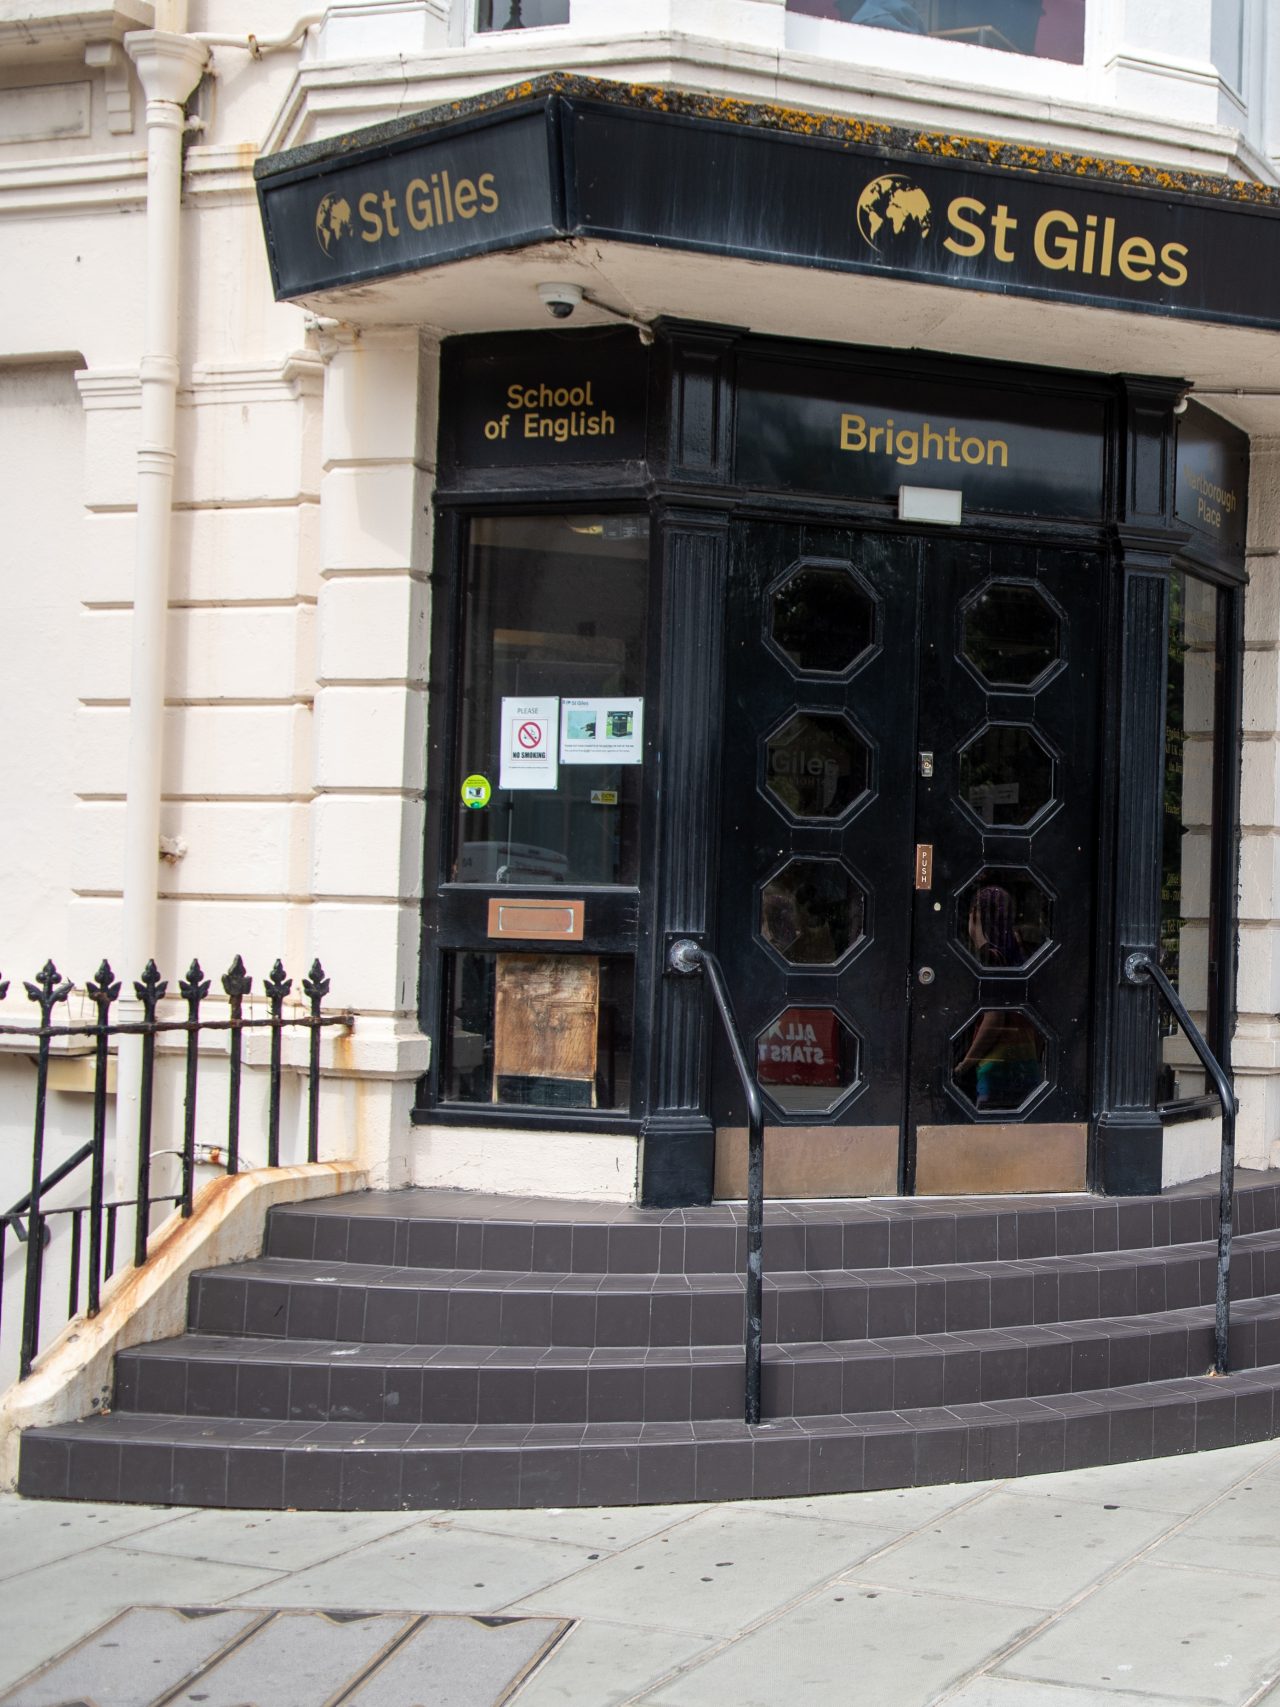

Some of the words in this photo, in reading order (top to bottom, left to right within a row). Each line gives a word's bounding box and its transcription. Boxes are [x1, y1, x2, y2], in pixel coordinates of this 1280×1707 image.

[358, 188, 400, 243] St
[405, 170, 499, 232] Giles
[942, 196, 1018, 263] St
[1033, 209, 1189, 287] Giles
[506, 381, 594, 410] School
[484, 418, 510, 442] of
[524, 410, 616, 443] English
[839, 413, 1009, 467] Brighton
[1197, 497, 1221, 528] Place
[512, 751, 520, 759] NO
[521, 751, 546, 759] SMOKING
